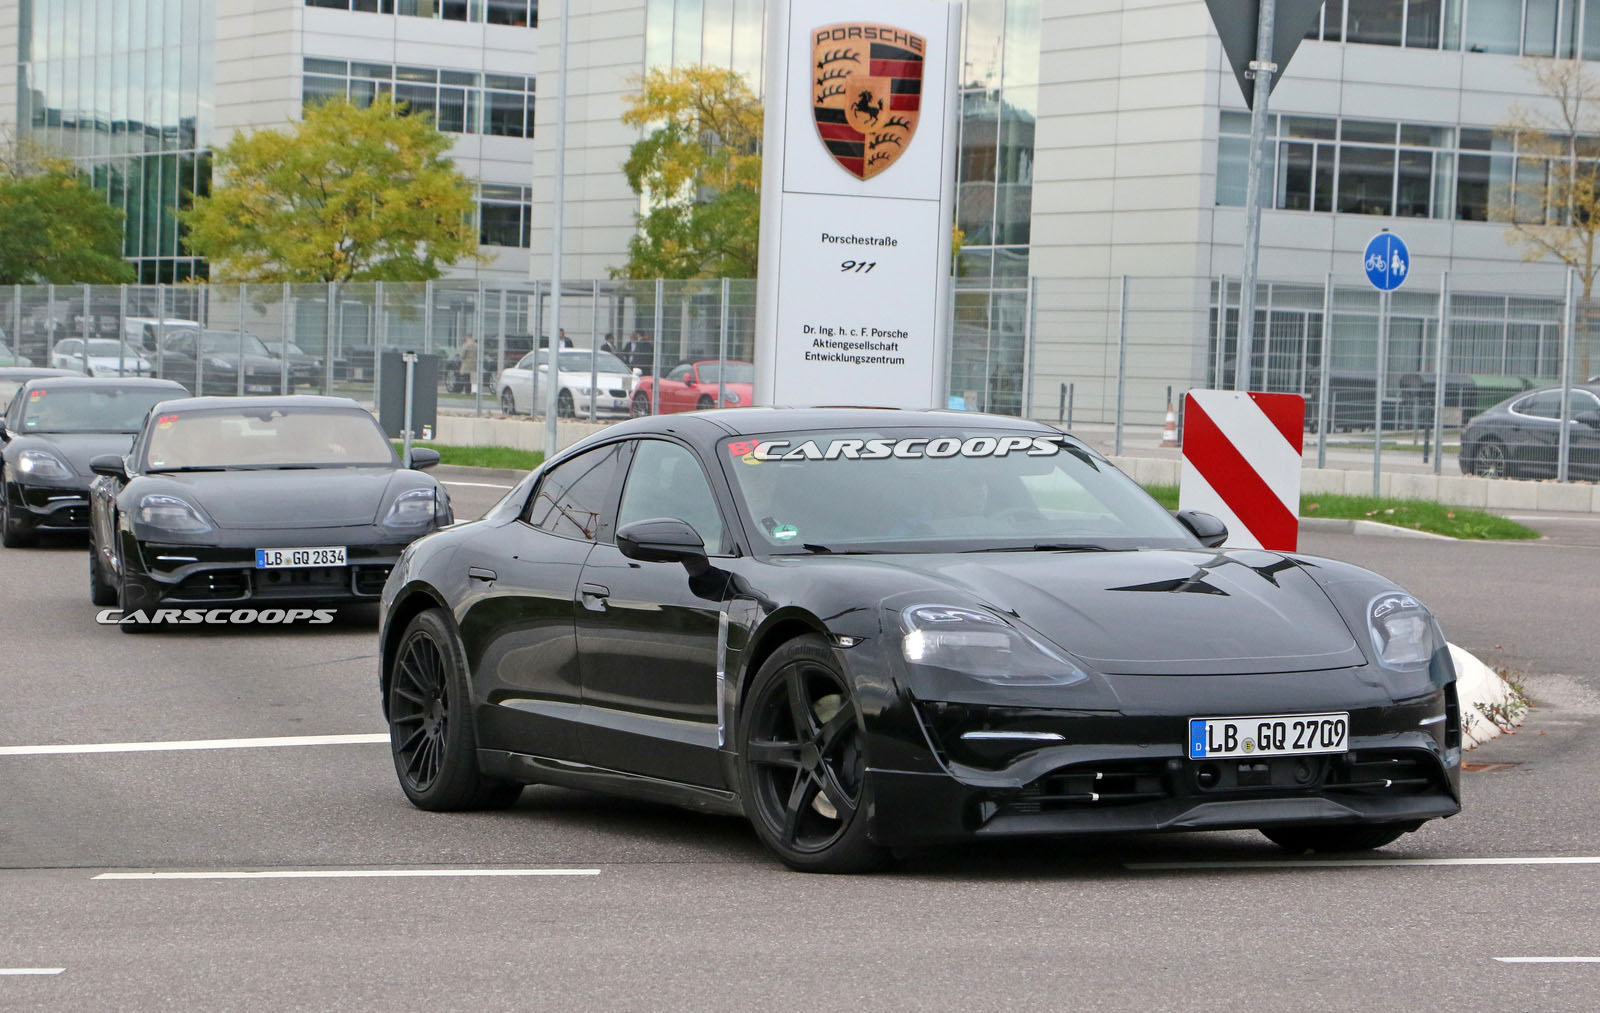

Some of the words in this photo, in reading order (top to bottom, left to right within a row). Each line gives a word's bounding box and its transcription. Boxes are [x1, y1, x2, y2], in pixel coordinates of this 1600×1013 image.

[816, 26, 923, 51] PORSCHE
[821, 232, 898, 247] Porschestraße
[841, 260, 877, 274] 911
[803, 324, 817, 335] Dr.
[819, 325, 836, 337] Ing.
[839, 326, 848, 336] h.
[861, 327, 869, 337] F.
[871, 327, 909, 339] Porsche
[812, 338, 899, 352] Aktiengesellschaft
[805, 351, 905, 365] Entwicklungszentrum
[265, 552, 283, 566] LB
[293, 551, 310, 565] GQ
[313, 550, 344, 564] 2834
[1195, 742, 1202, 751] D
[1208, 723, 1238, 753] LB
[1257, 721, 1287, 751] GQ
[1292, 719, 1346, 750] 2709
